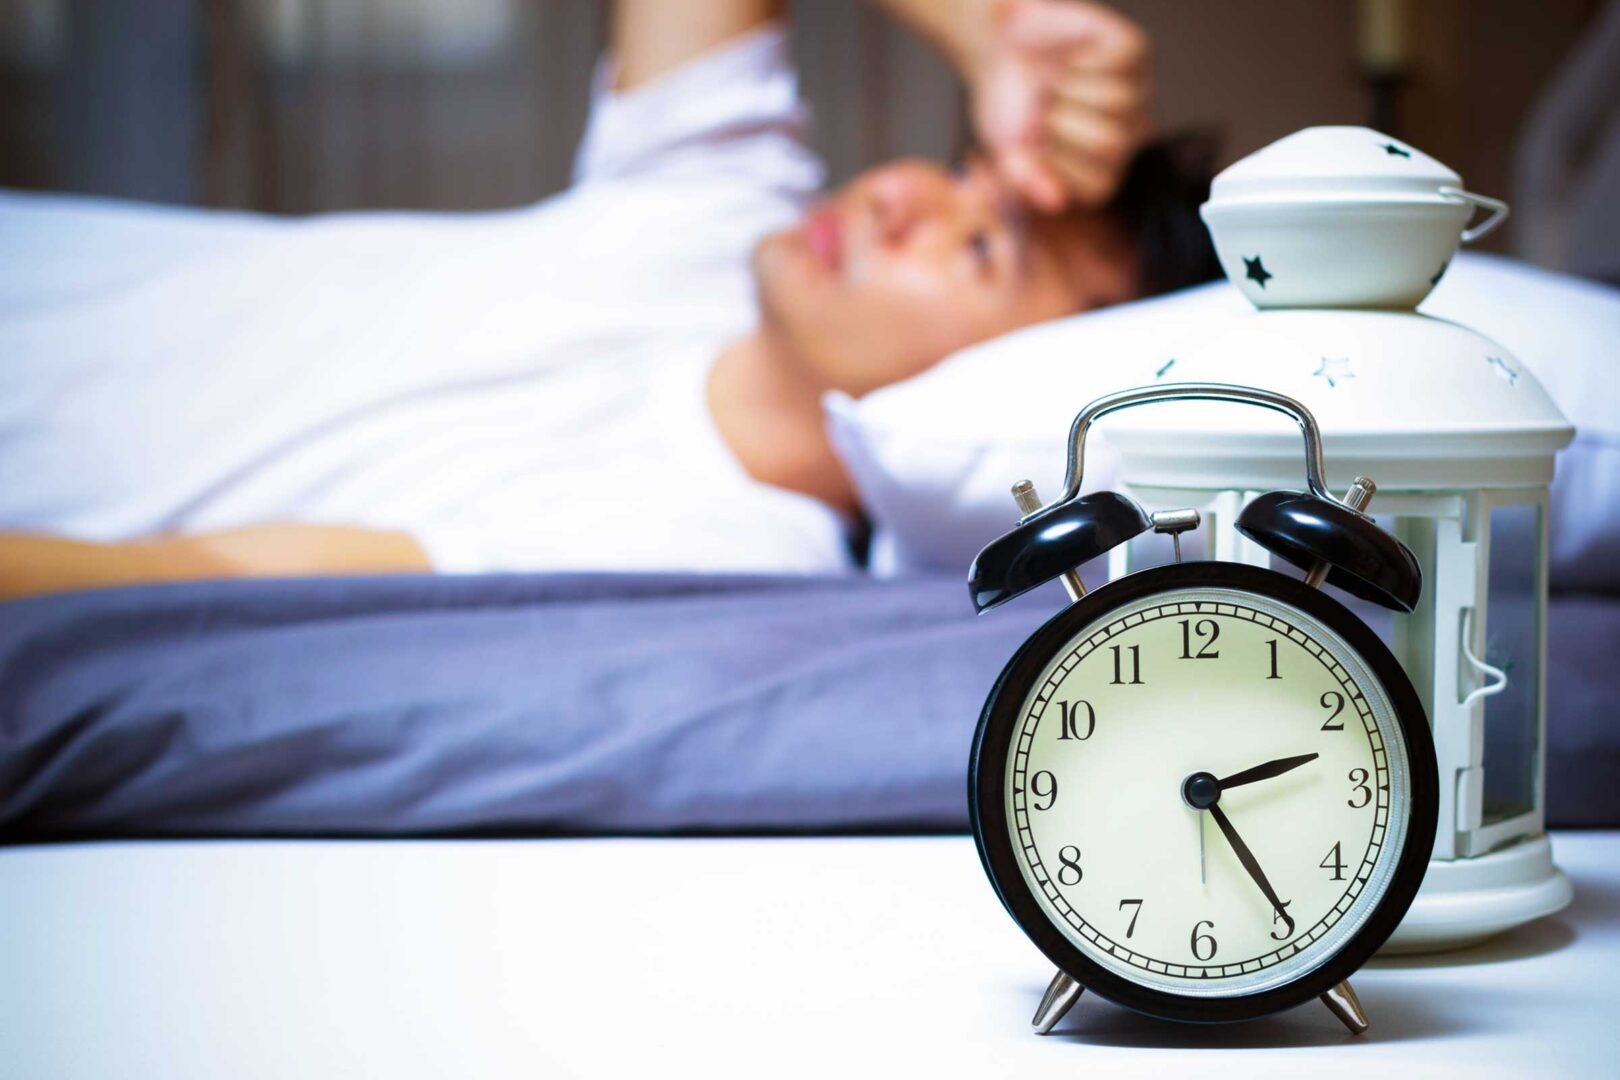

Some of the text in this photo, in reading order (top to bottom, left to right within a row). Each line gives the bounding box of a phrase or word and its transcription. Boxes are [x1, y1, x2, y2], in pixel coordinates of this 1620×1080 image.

[1177, 619, 1220, 660] 12
[1265, 639, 1283, 680] 1
[1108, 644, 1146, 685] 11
[1056, 699, 1096, 741] 10
[1319, 691, 1346, 731] 2
[1030, 770, 1058, 811] 9
[1347, 767, 1373, 809] 3
[1057, 845, 1083, 886] 8
[1319, 841, 1348, 881] 4
[1118, 898, 1144, 939] 7
[1270, 899, 1296, 941] 5
[1190, 921, 1218, 962] 6
